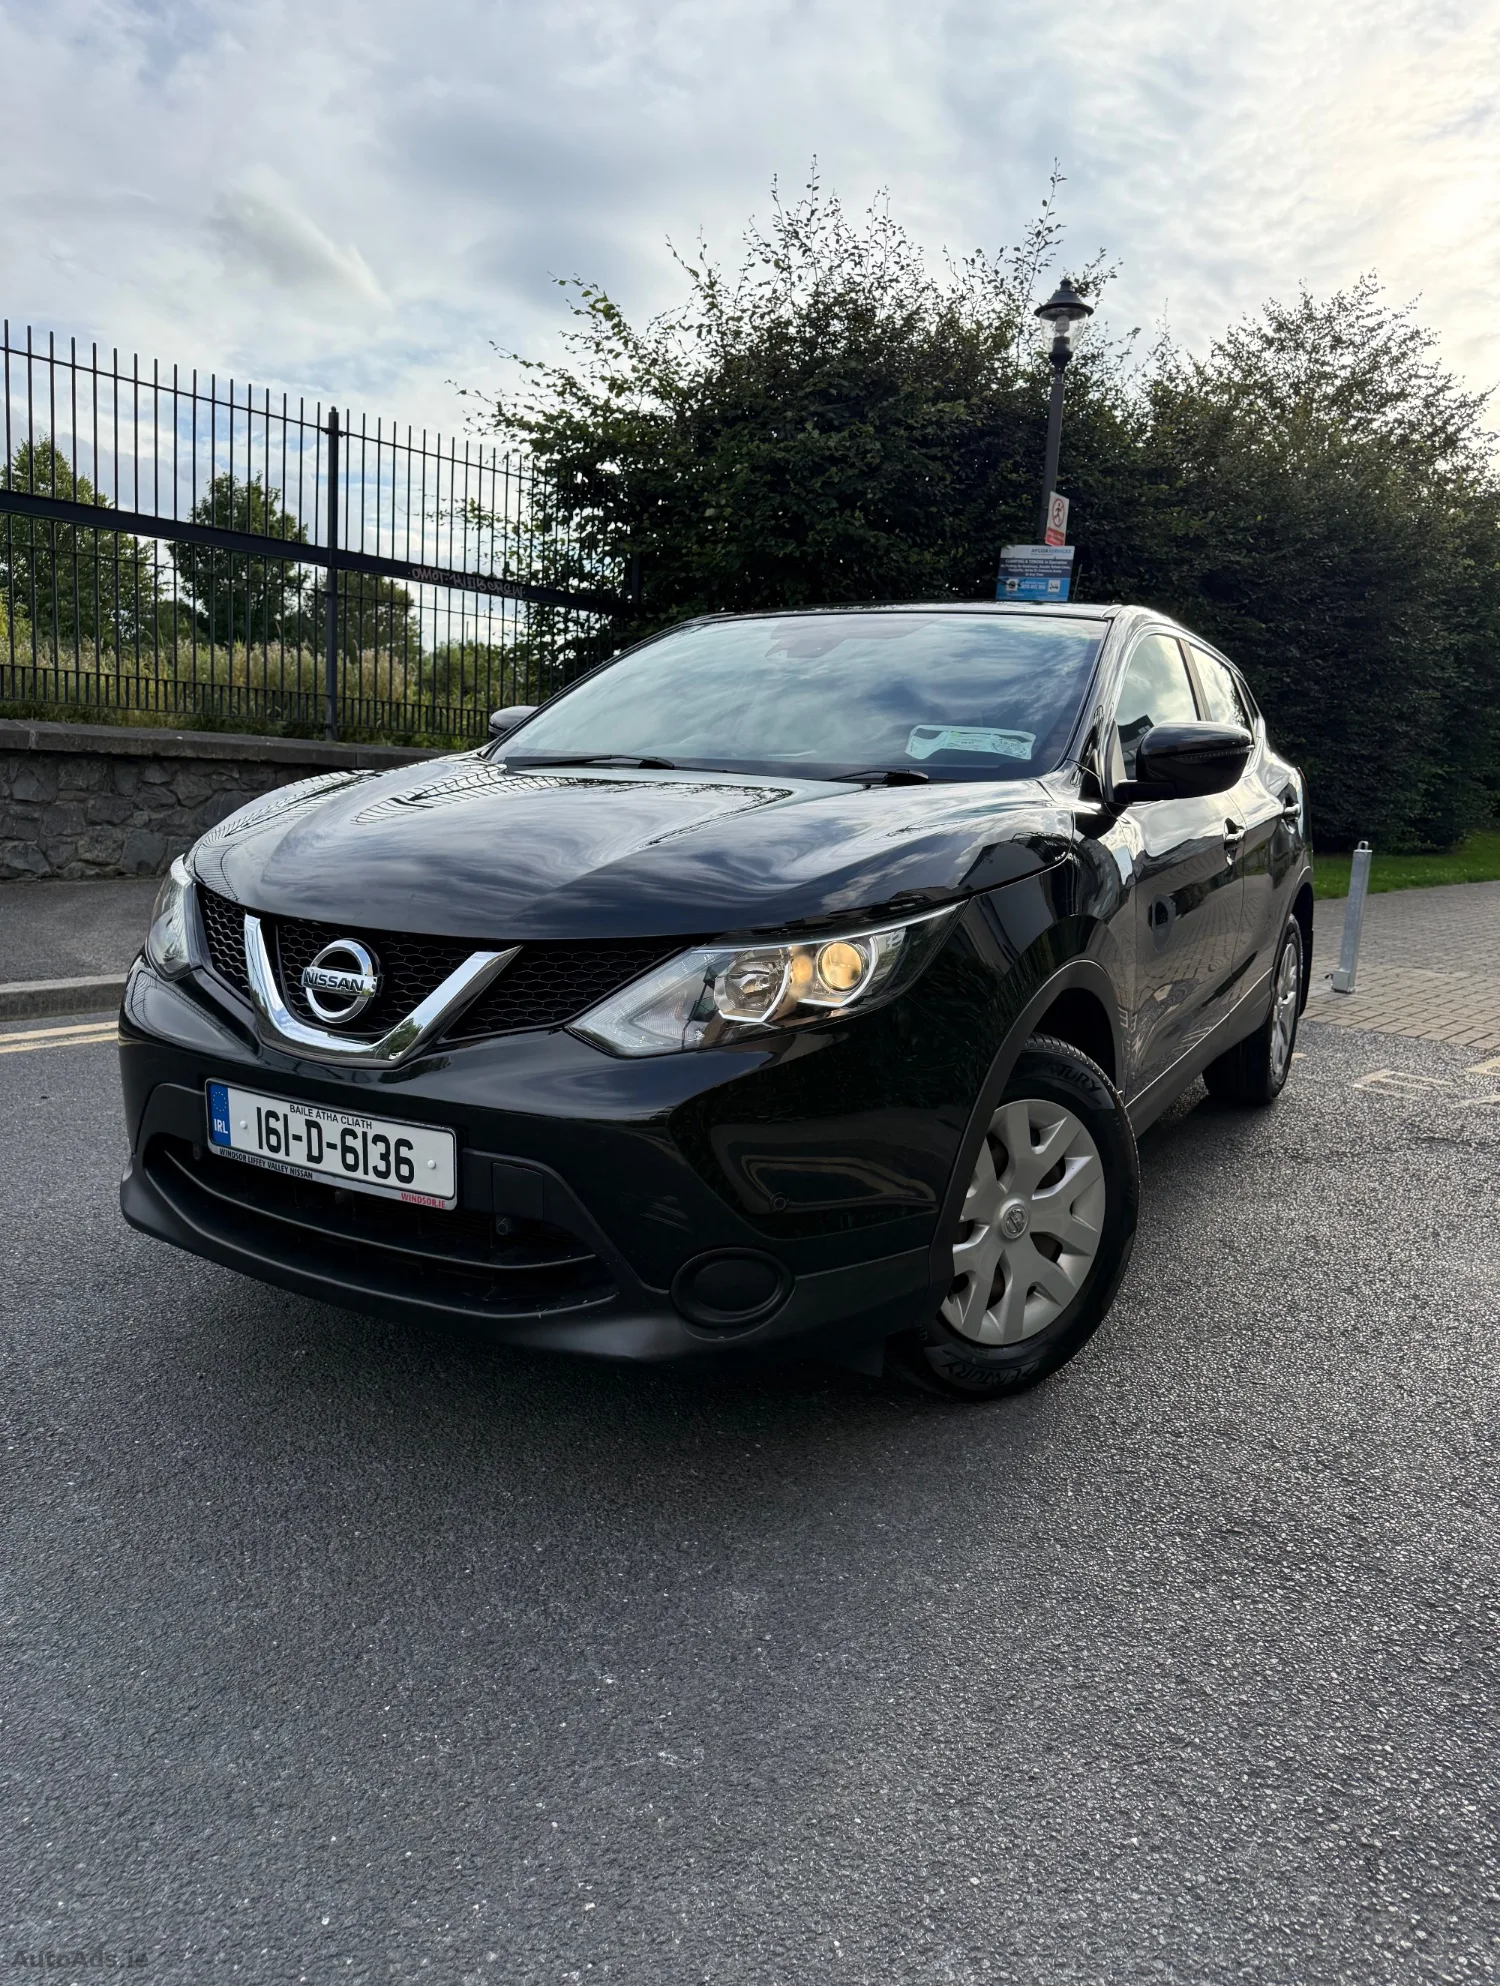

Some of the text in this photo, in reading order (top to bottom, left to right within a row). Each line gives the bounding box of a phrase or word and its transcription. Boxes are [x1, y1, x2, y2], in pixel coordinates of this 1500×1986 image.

[303, 969, 365, 992] NISSAN
[213, 1118, 229, 1135] IRL
[289, 1104, 314, 1118] BAILE
[340, 1116, 372, 1130] CLIATH
[256, 1106, 415, 1185] 161-D-6136
[219, 1147, 313, 1180] WINDSOR LIFFEY VALLEY NISSAN
[401, 1192, 446, 1209] WINDSOR.IE
